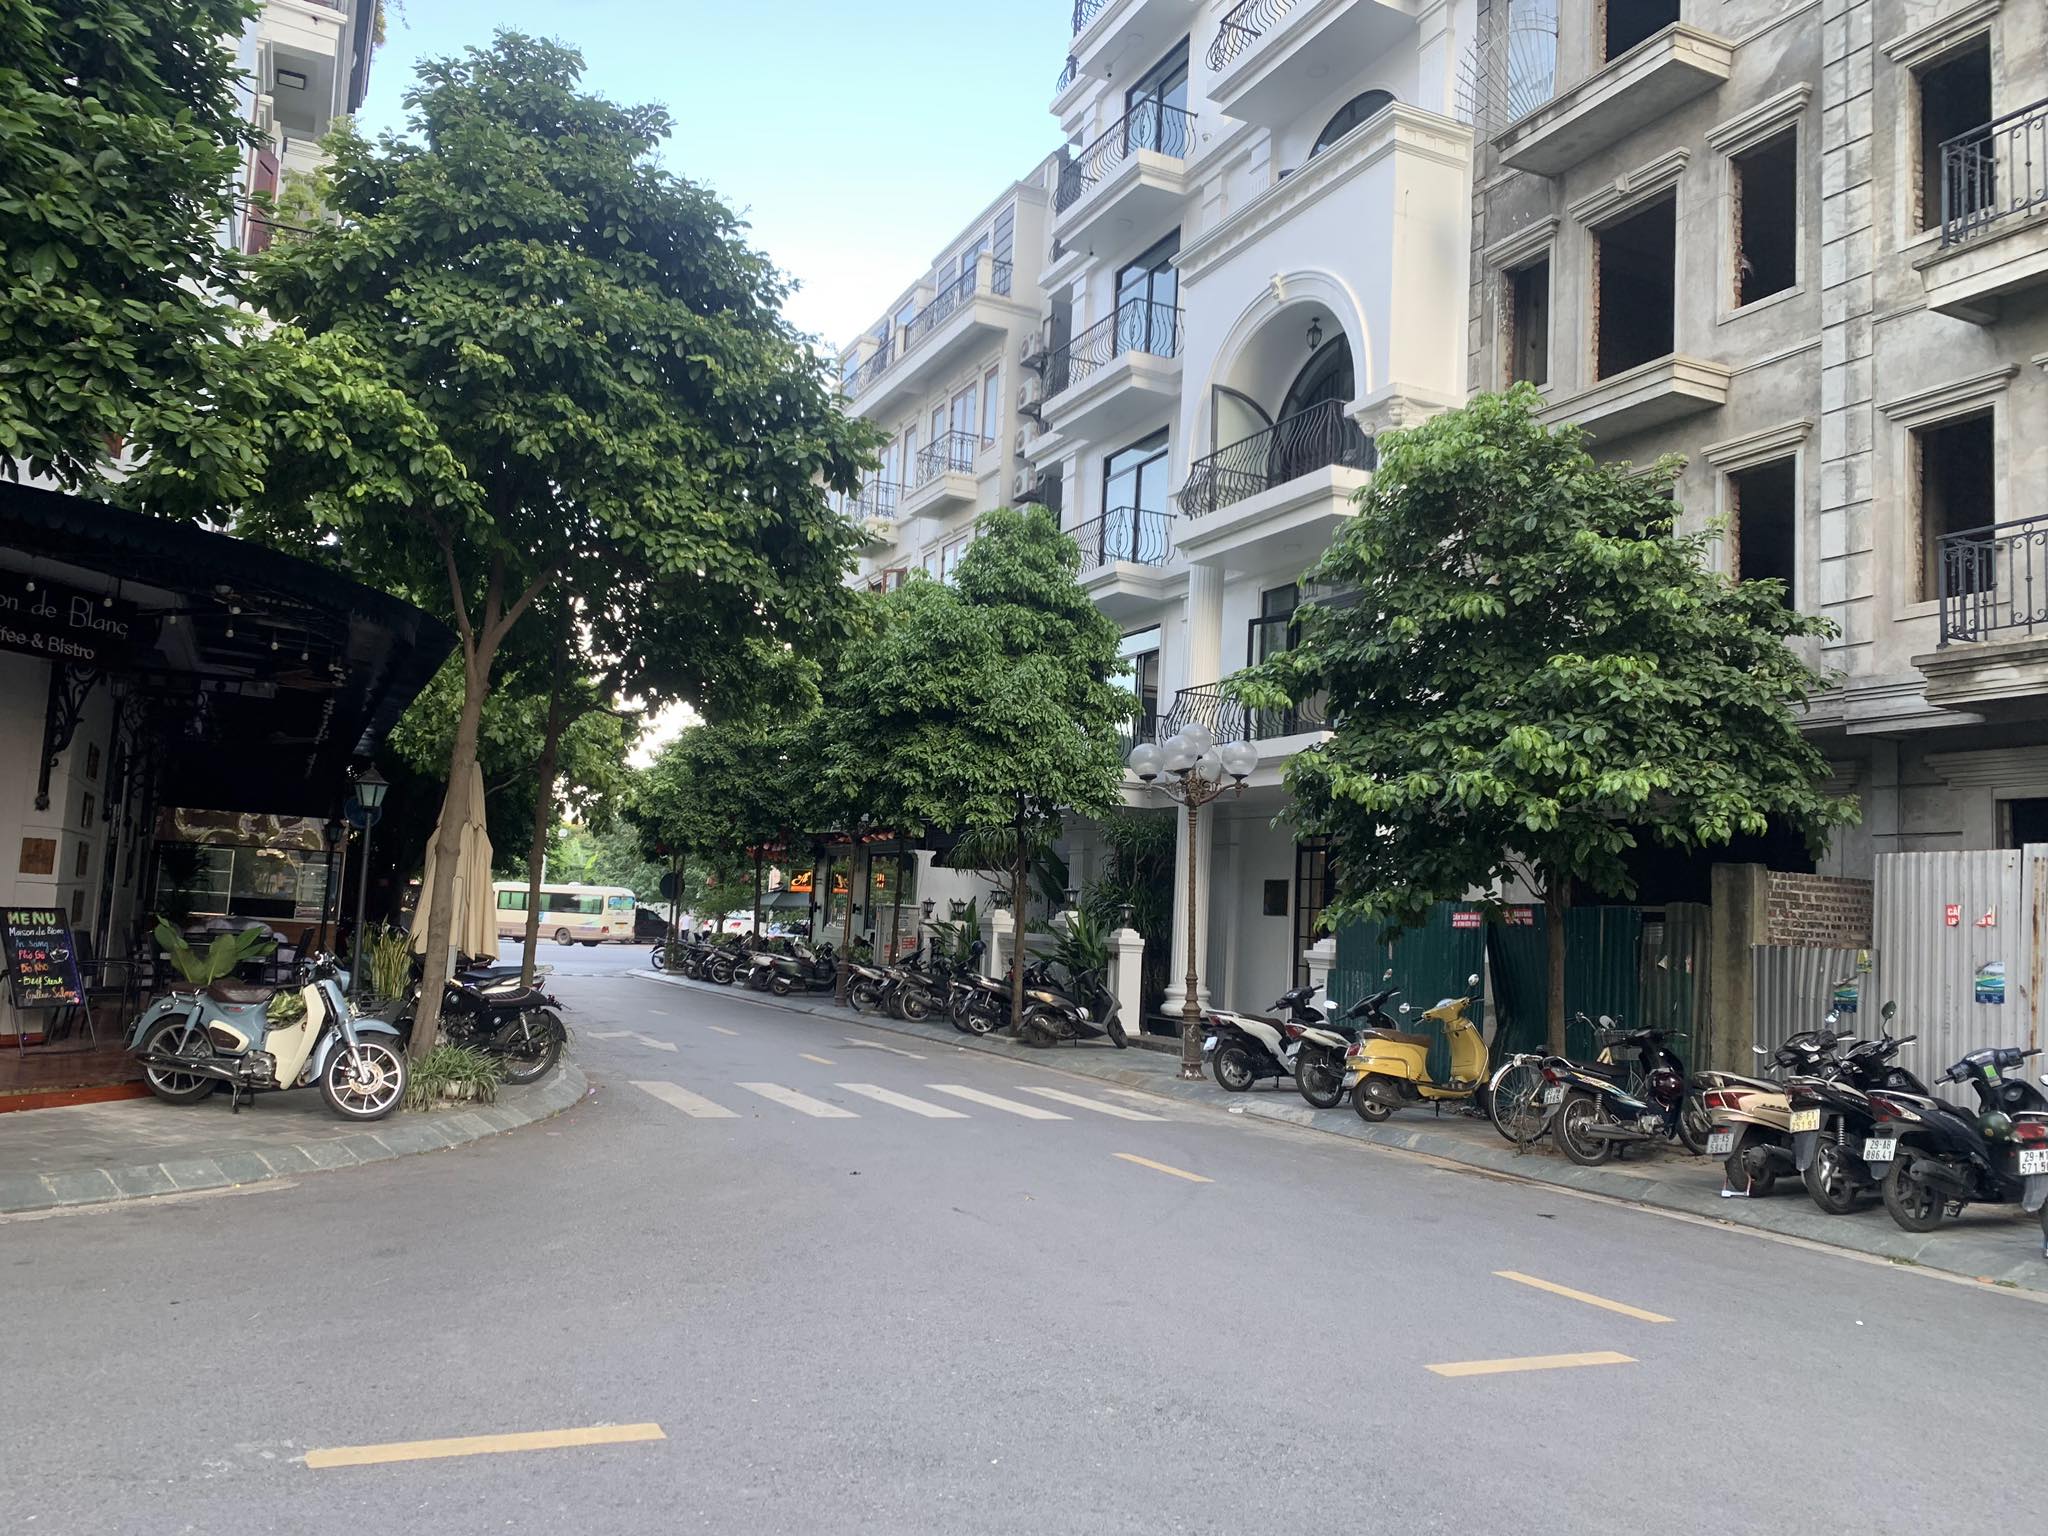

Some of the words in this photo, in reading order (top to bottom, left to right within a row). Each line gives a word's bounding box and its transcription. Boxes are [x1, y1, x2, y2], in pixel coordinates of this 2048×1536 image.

[31, 590, 57, 618] de
[31, 632, 44, 649] &
[48, 636, 95, 660] Bistro
[7, 911, 56, 925] MENU
